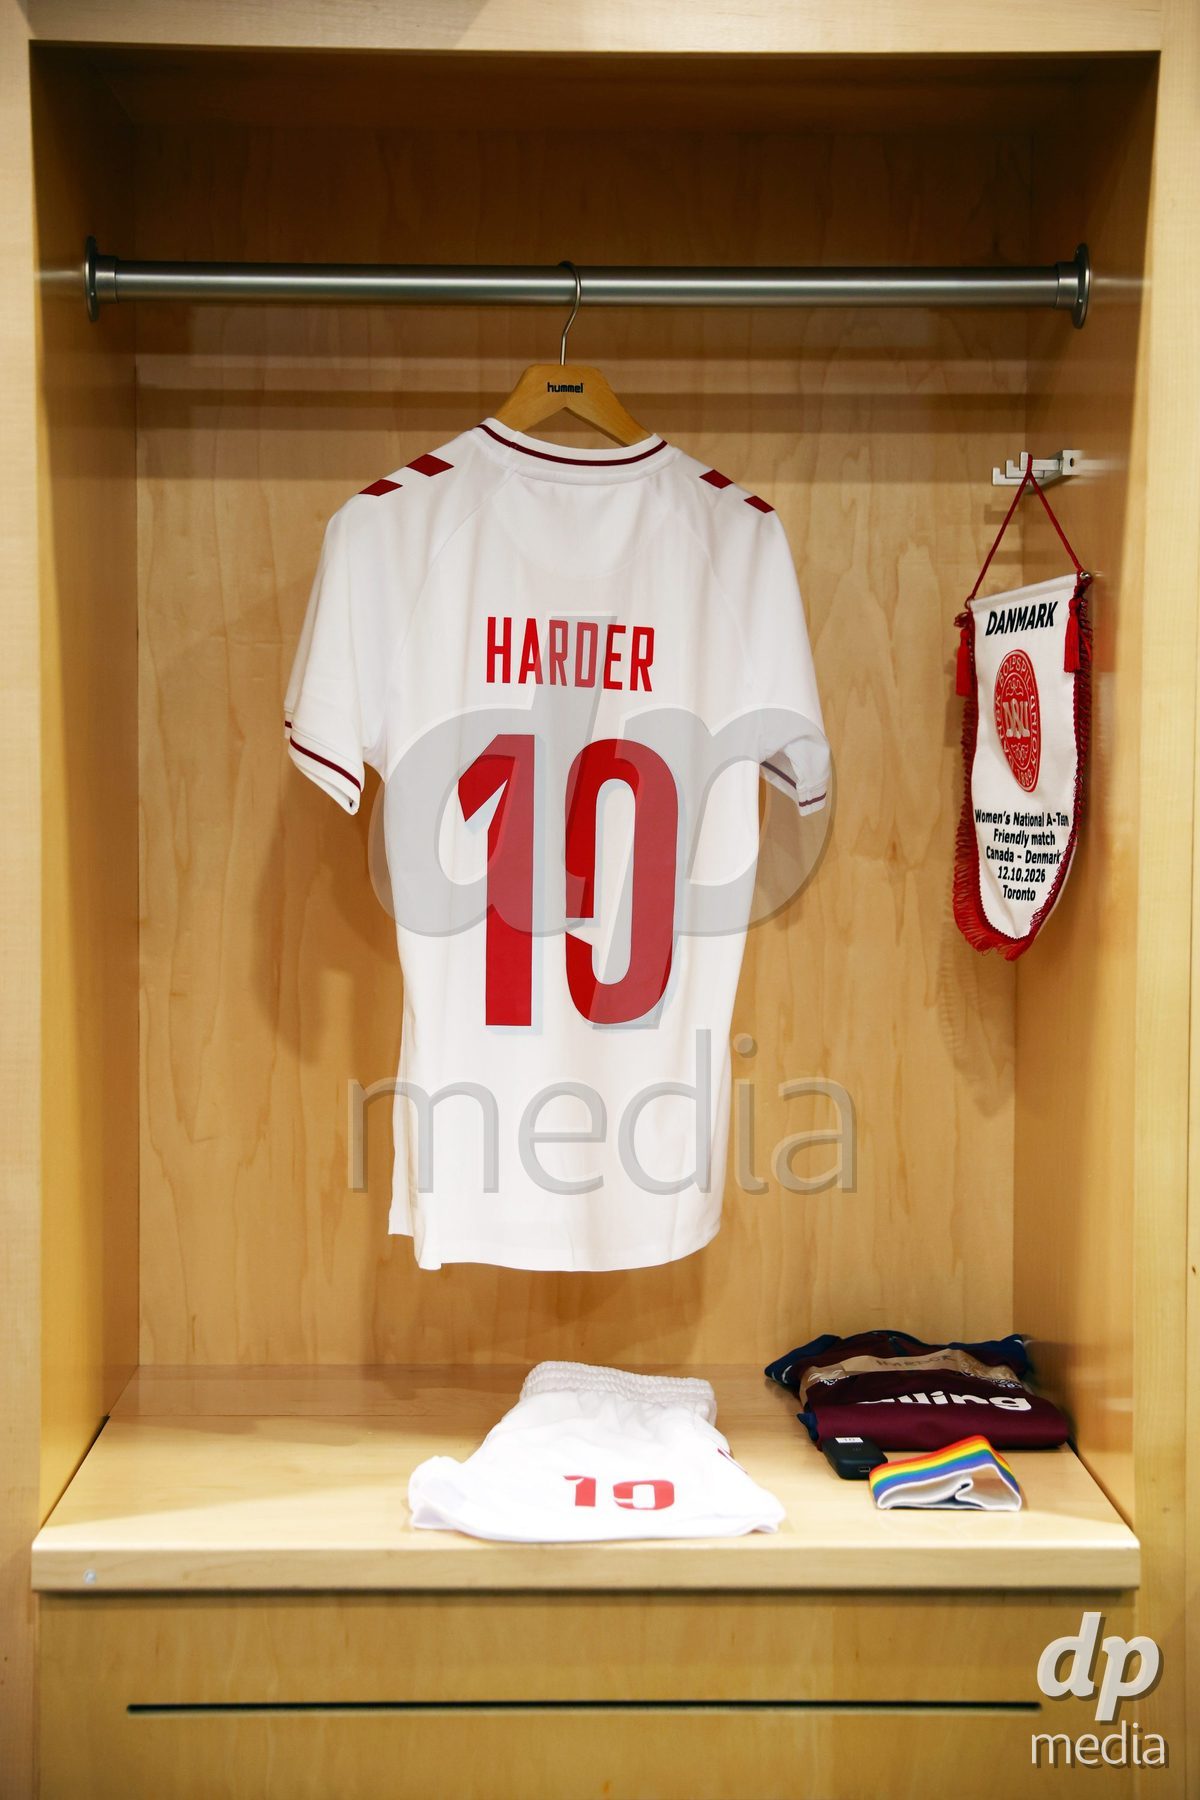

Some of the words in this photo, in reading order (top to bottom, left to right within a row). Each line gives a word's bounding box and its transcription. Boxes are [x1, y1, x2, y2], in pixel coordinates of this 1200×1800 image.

[547, 381, 584, 394] hummel
[985, 601, 1059, 636] DANMARK
[486, 616, 655, 692] HARDER
[1013, 812, 1045, 828] National
[993, 828, 1030, 848] Friendly
[1031, 831, 1055, 846] match
[986, 845, 1014, 863] Canada
[1025, 849, 1061, 865] Denmark
[458, 733, 679, 1027] 10
[997, 865, 1046, 883] 12.10.2026
[1002, 884, 1036, 901] Toronto
[563, 1475, 675, 1511] 10
